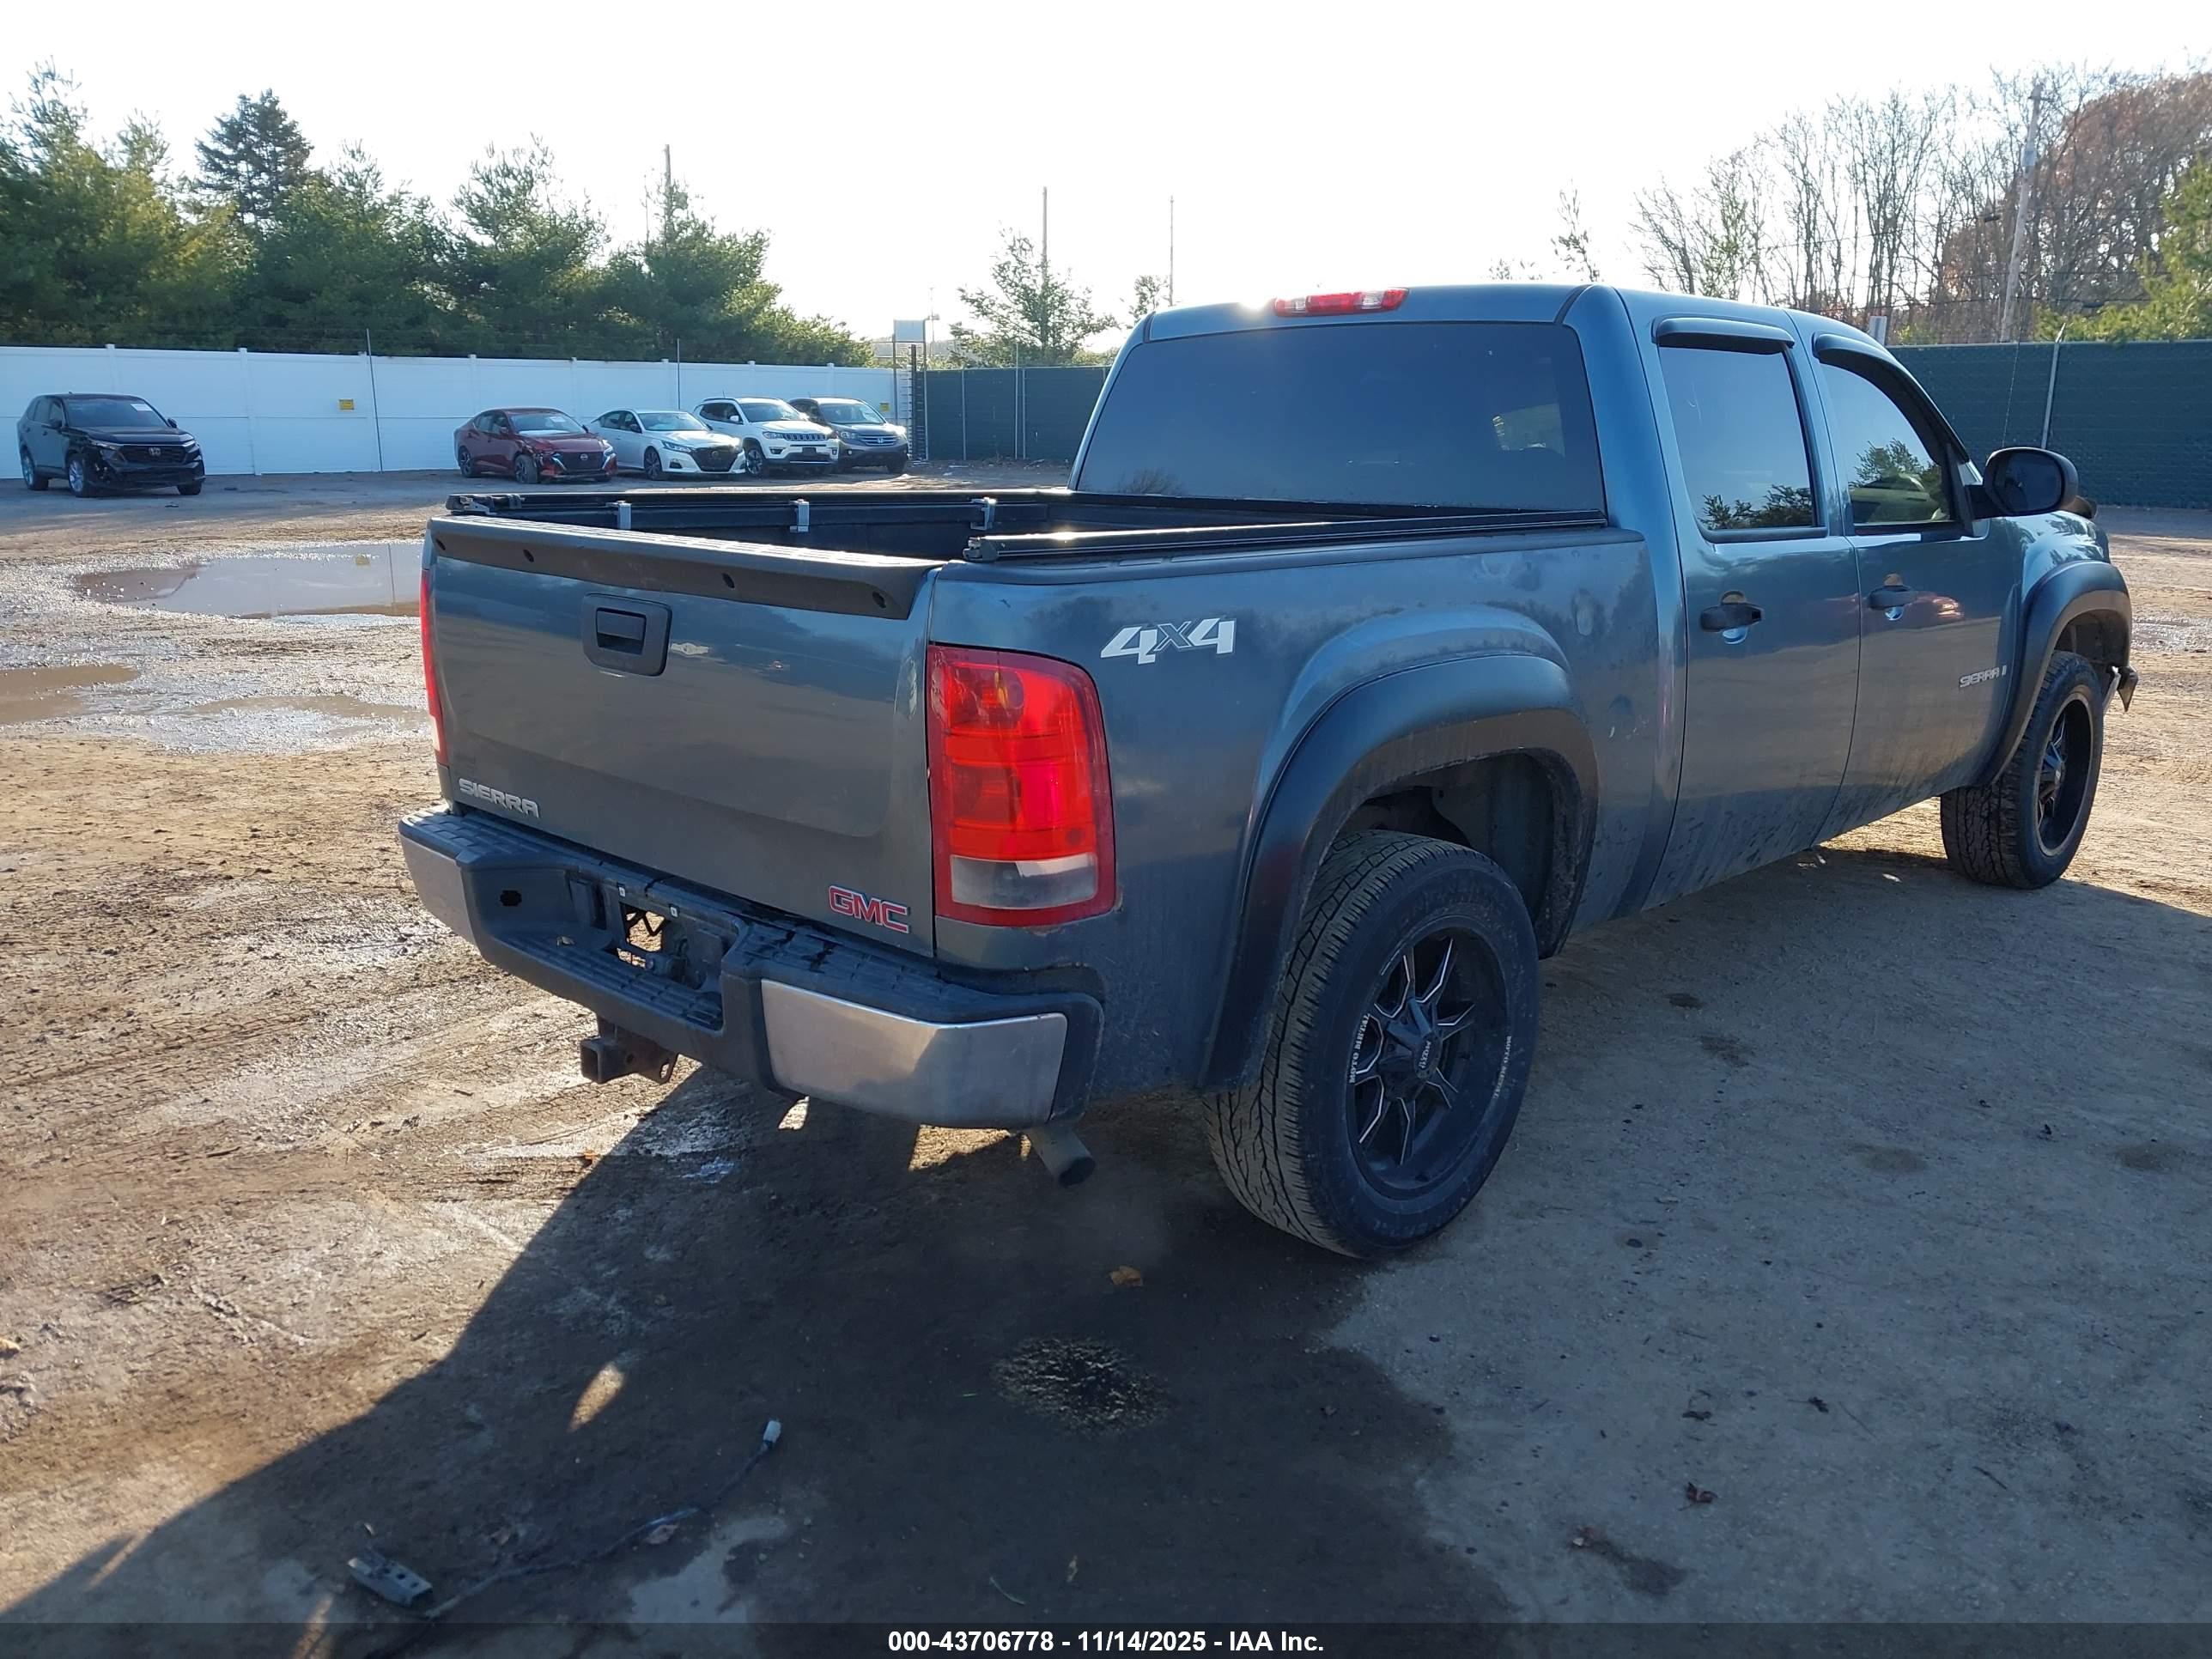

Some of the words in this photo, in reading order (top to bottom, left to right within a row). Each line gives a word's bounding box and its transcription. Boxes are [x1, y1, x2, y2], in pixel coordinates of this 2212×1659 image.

[1960, 666, 2000, 688] SIERRA
[459, 778, 539, 818] SIERRA
[829, 885, 909, 934] GMC
